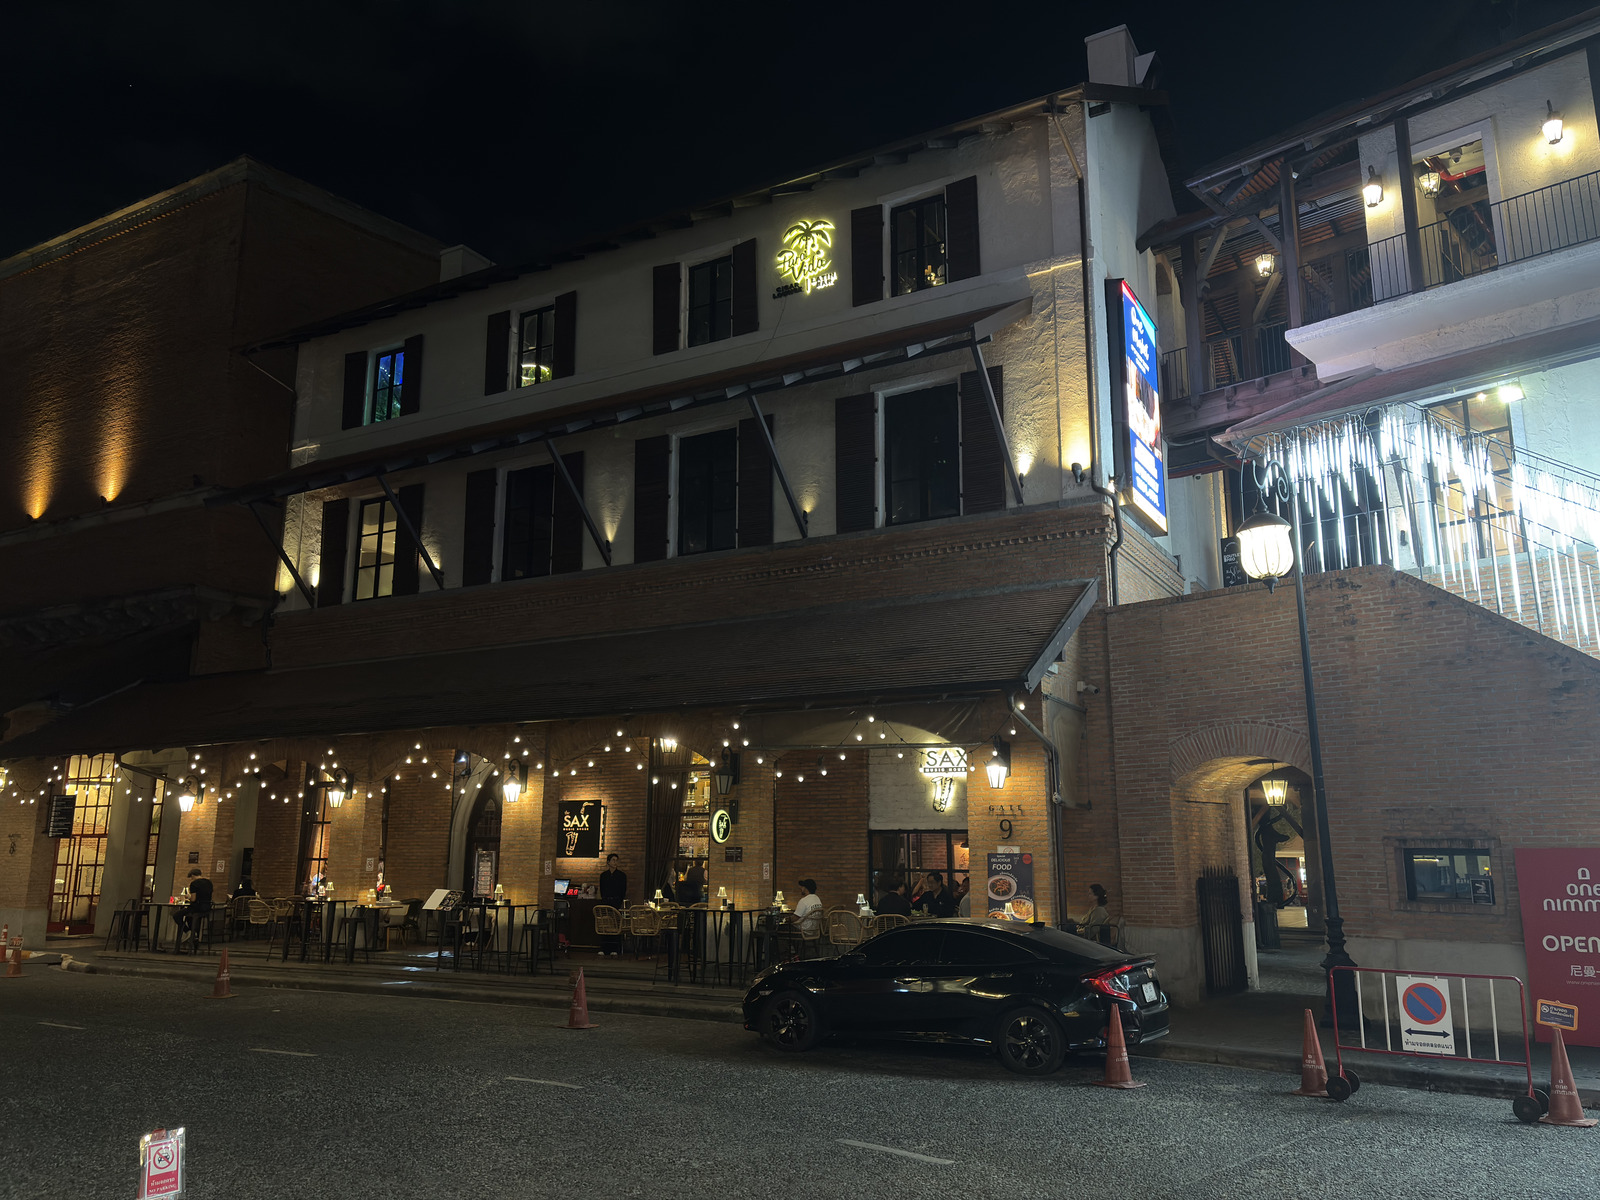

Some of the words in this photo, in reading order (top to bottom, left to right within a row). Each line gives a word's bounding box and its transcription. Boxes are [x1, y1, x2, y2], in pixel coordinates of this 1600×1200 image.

[791, 255, 831, 281] Vida
[926, 749, 967, 766] SAX
[563, 814, 590, 828] SAX
[999, 818, 1013, 840] 9
[992, 863, 1012, 871] FOOD
[1566, 883, 1600, 896] one
[1542, 934, 1600, 953] OPEN
